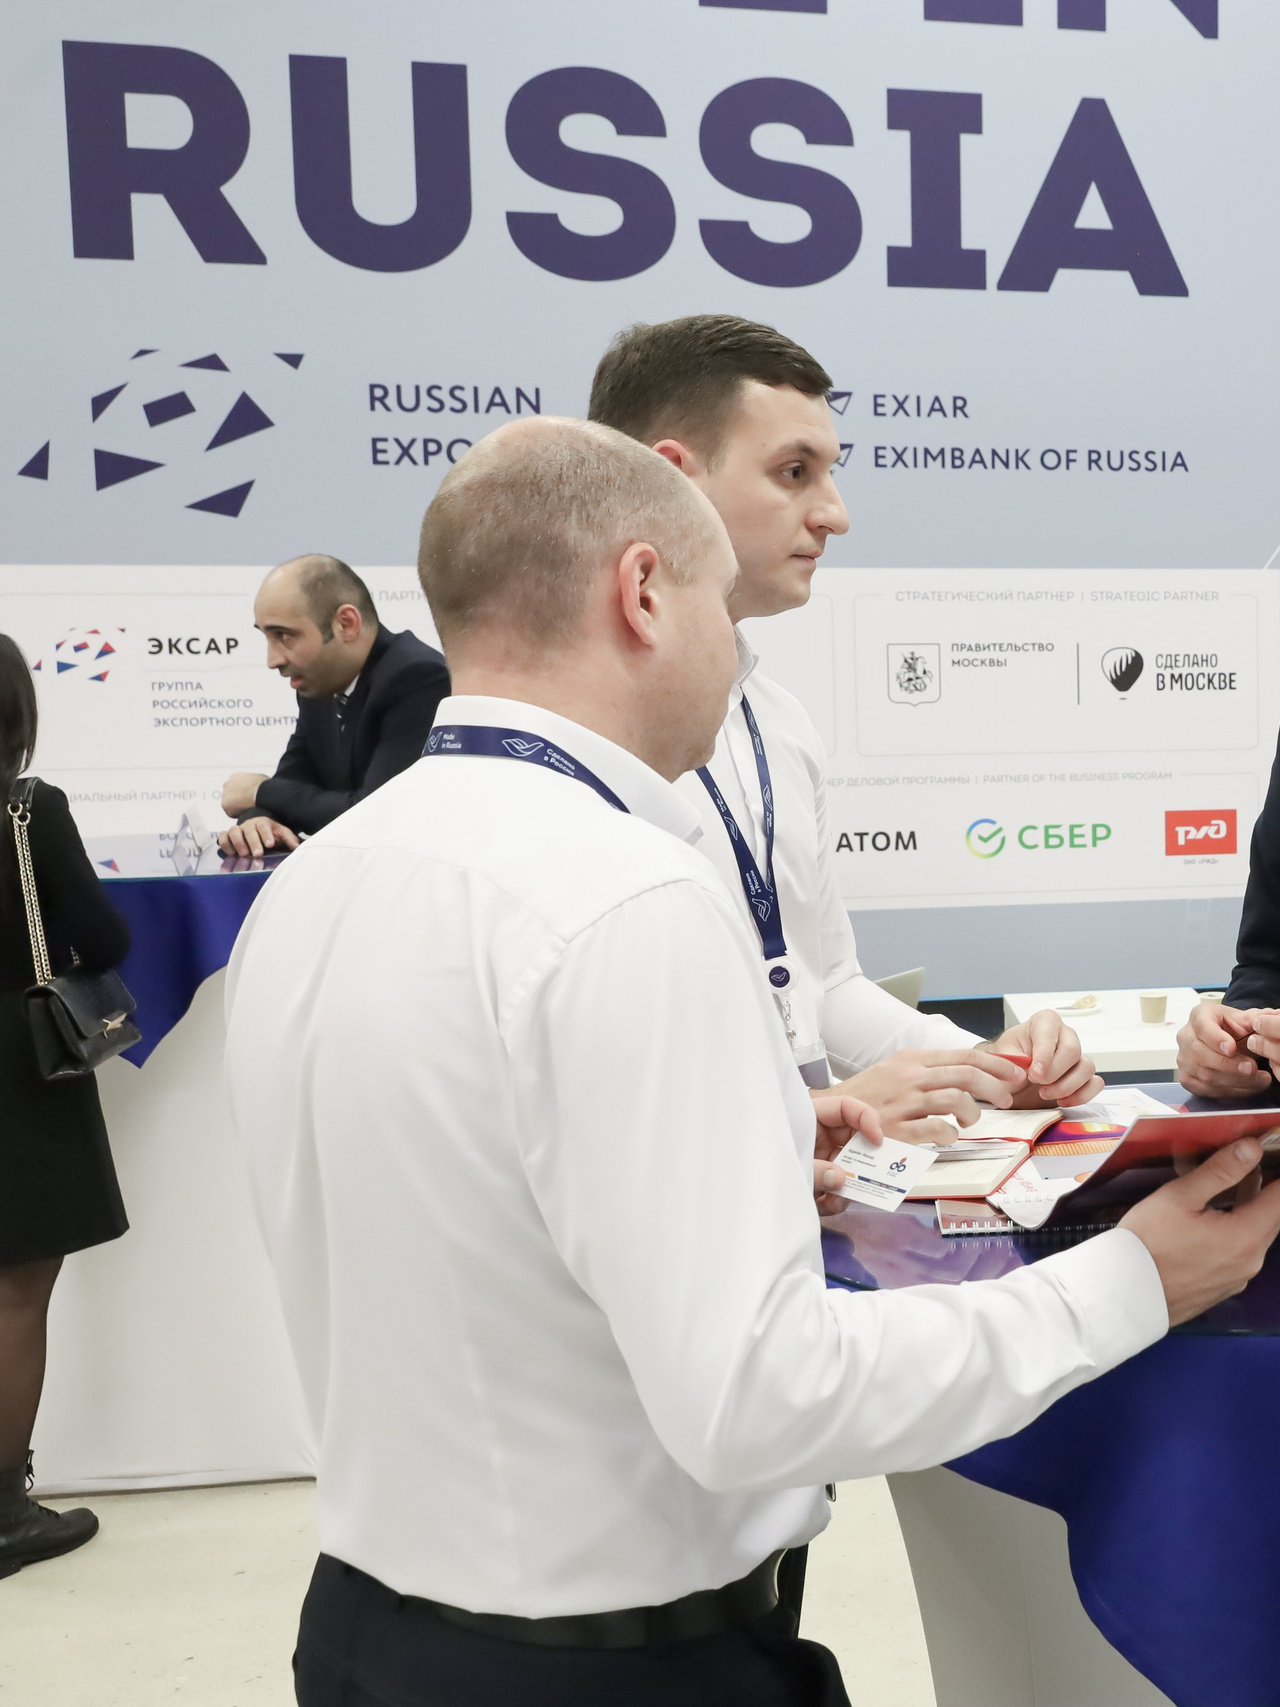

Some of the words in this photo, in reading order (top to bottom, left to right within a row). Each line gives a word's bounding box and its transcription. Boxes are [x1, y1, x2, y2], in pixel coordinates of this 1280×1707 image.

[62, 40, 1190, 297] RUSSIA
[368, 383, 541, 415] RUSSIAN
[873, 394, 969, 418] EXIAR
[874, 446, 1031, 471] EXIMBANK
[1040, 448, 1078, 471] OF
[1087, 449, 1189, 473] RUSSIA
[895, 589, 1013, 602] СТРАТЕГИЧЕСКИЙ
[1016, 590, 1074, 602] ПАРТНЕР
[1090, 590, 1160, 602] STRATEGIC
[1164, 590, 1219, 602] PARTNER
[148, 637, 239, 655] ЭКСАР
[951, 643, 1055, 653] ПРАВИТЕЛЬСТВО
[951, 658, 1007, 668] МОСКВЫ
[1155, 653, 1218, 670] СДЕЛАНО
[151, 681, 204, 692] ГРУППА
[1156, 672, 1166, 691] В
[1170, 672, 1237, 691] МОСКВЕ
[152, 697, 253, 709] РОССИЙСКОГО
[153, 716, 252, 728] ЭКСПОРТНОГО
[846, 775, 898, 787] ДЕЛОВОЙ
[902, 775, 970, 785] ПРОГРАММЫ
[983, 774, 1030, 784] PARTNER
[1032, 773, 1046, 783] OF
[1048, 773, 1067, 783] THE
[1069, 772, 1119, 782] BUSINESS
[1122, 771, 1172, 781] PROGRAM
[1018, 823, 1112, 849] СБЕР
